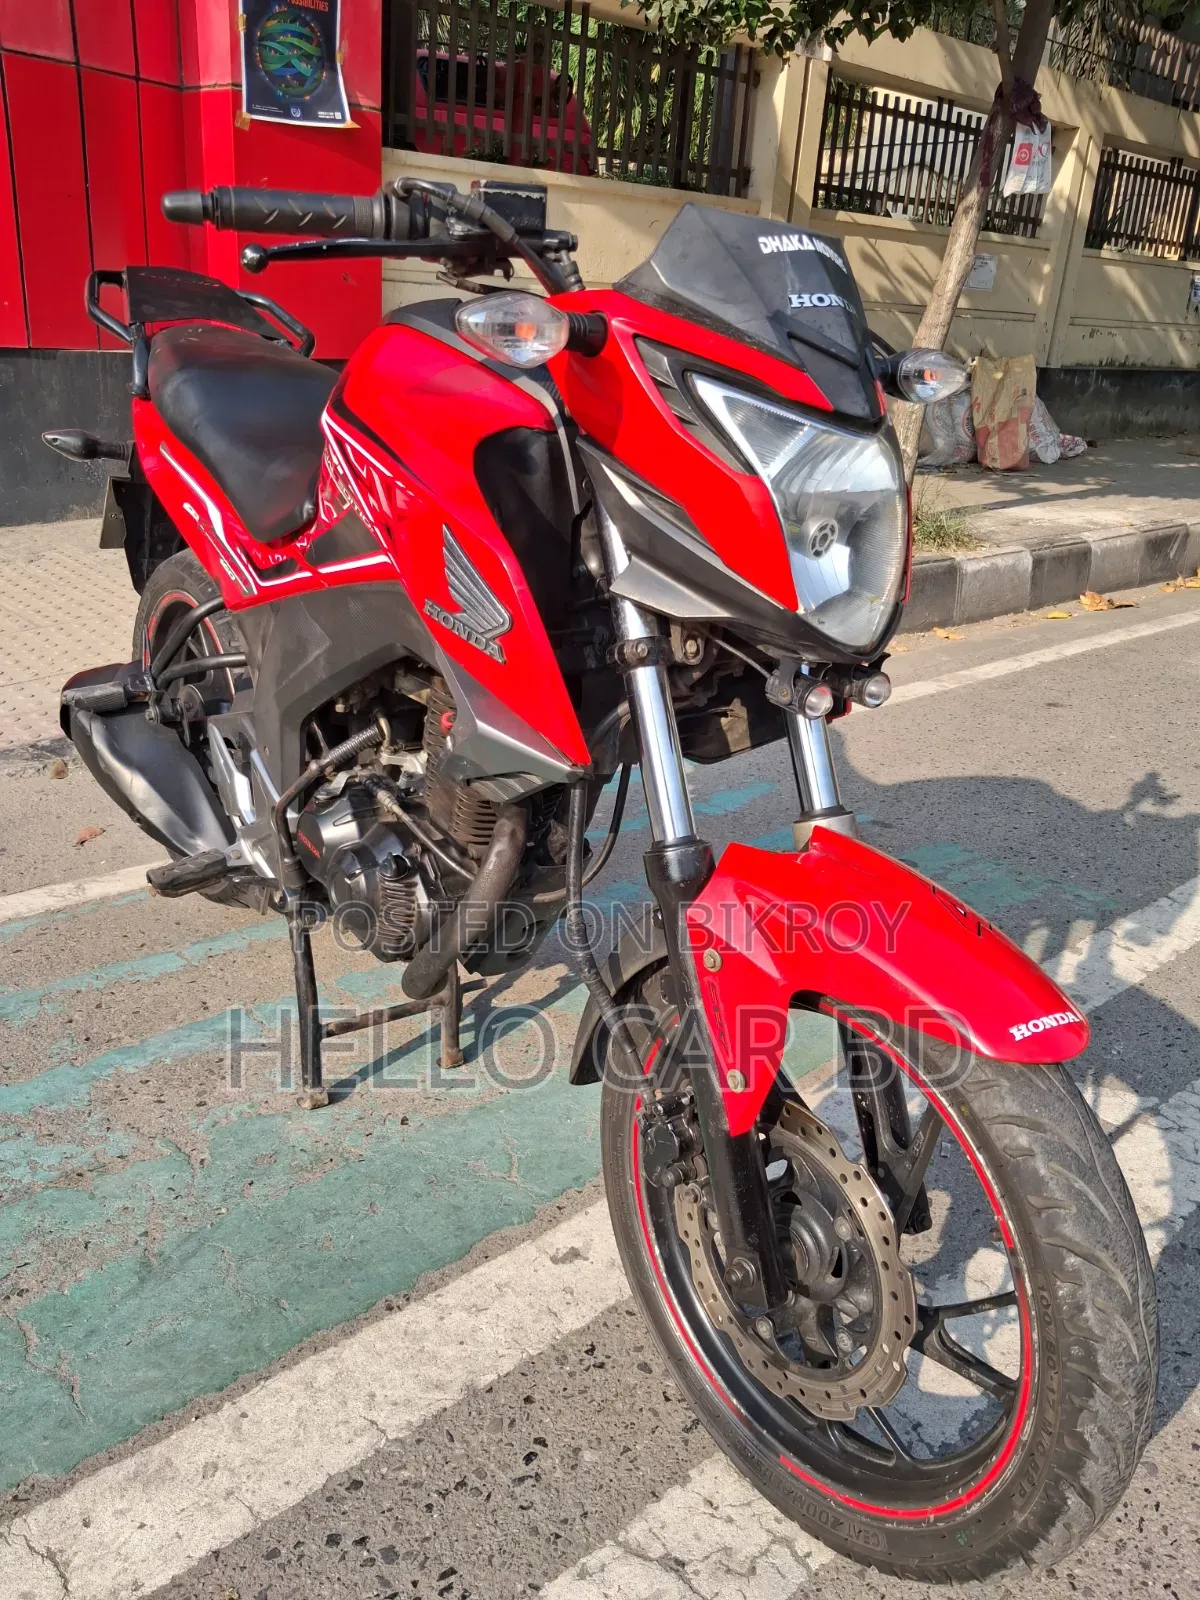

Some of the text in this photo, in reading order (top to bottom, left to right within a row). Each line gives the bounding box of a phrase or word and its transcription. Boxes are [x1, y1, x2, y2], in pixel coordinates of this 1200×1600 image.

[287, 0, 329, 12] SSIBILITIES
[758, 234, 815, 254] DHAKA
[789, 293, 860, 320] HOND
[423, 598, 507, 666] HONDA
[1009, 1011, 1082, 1042] HONDA
